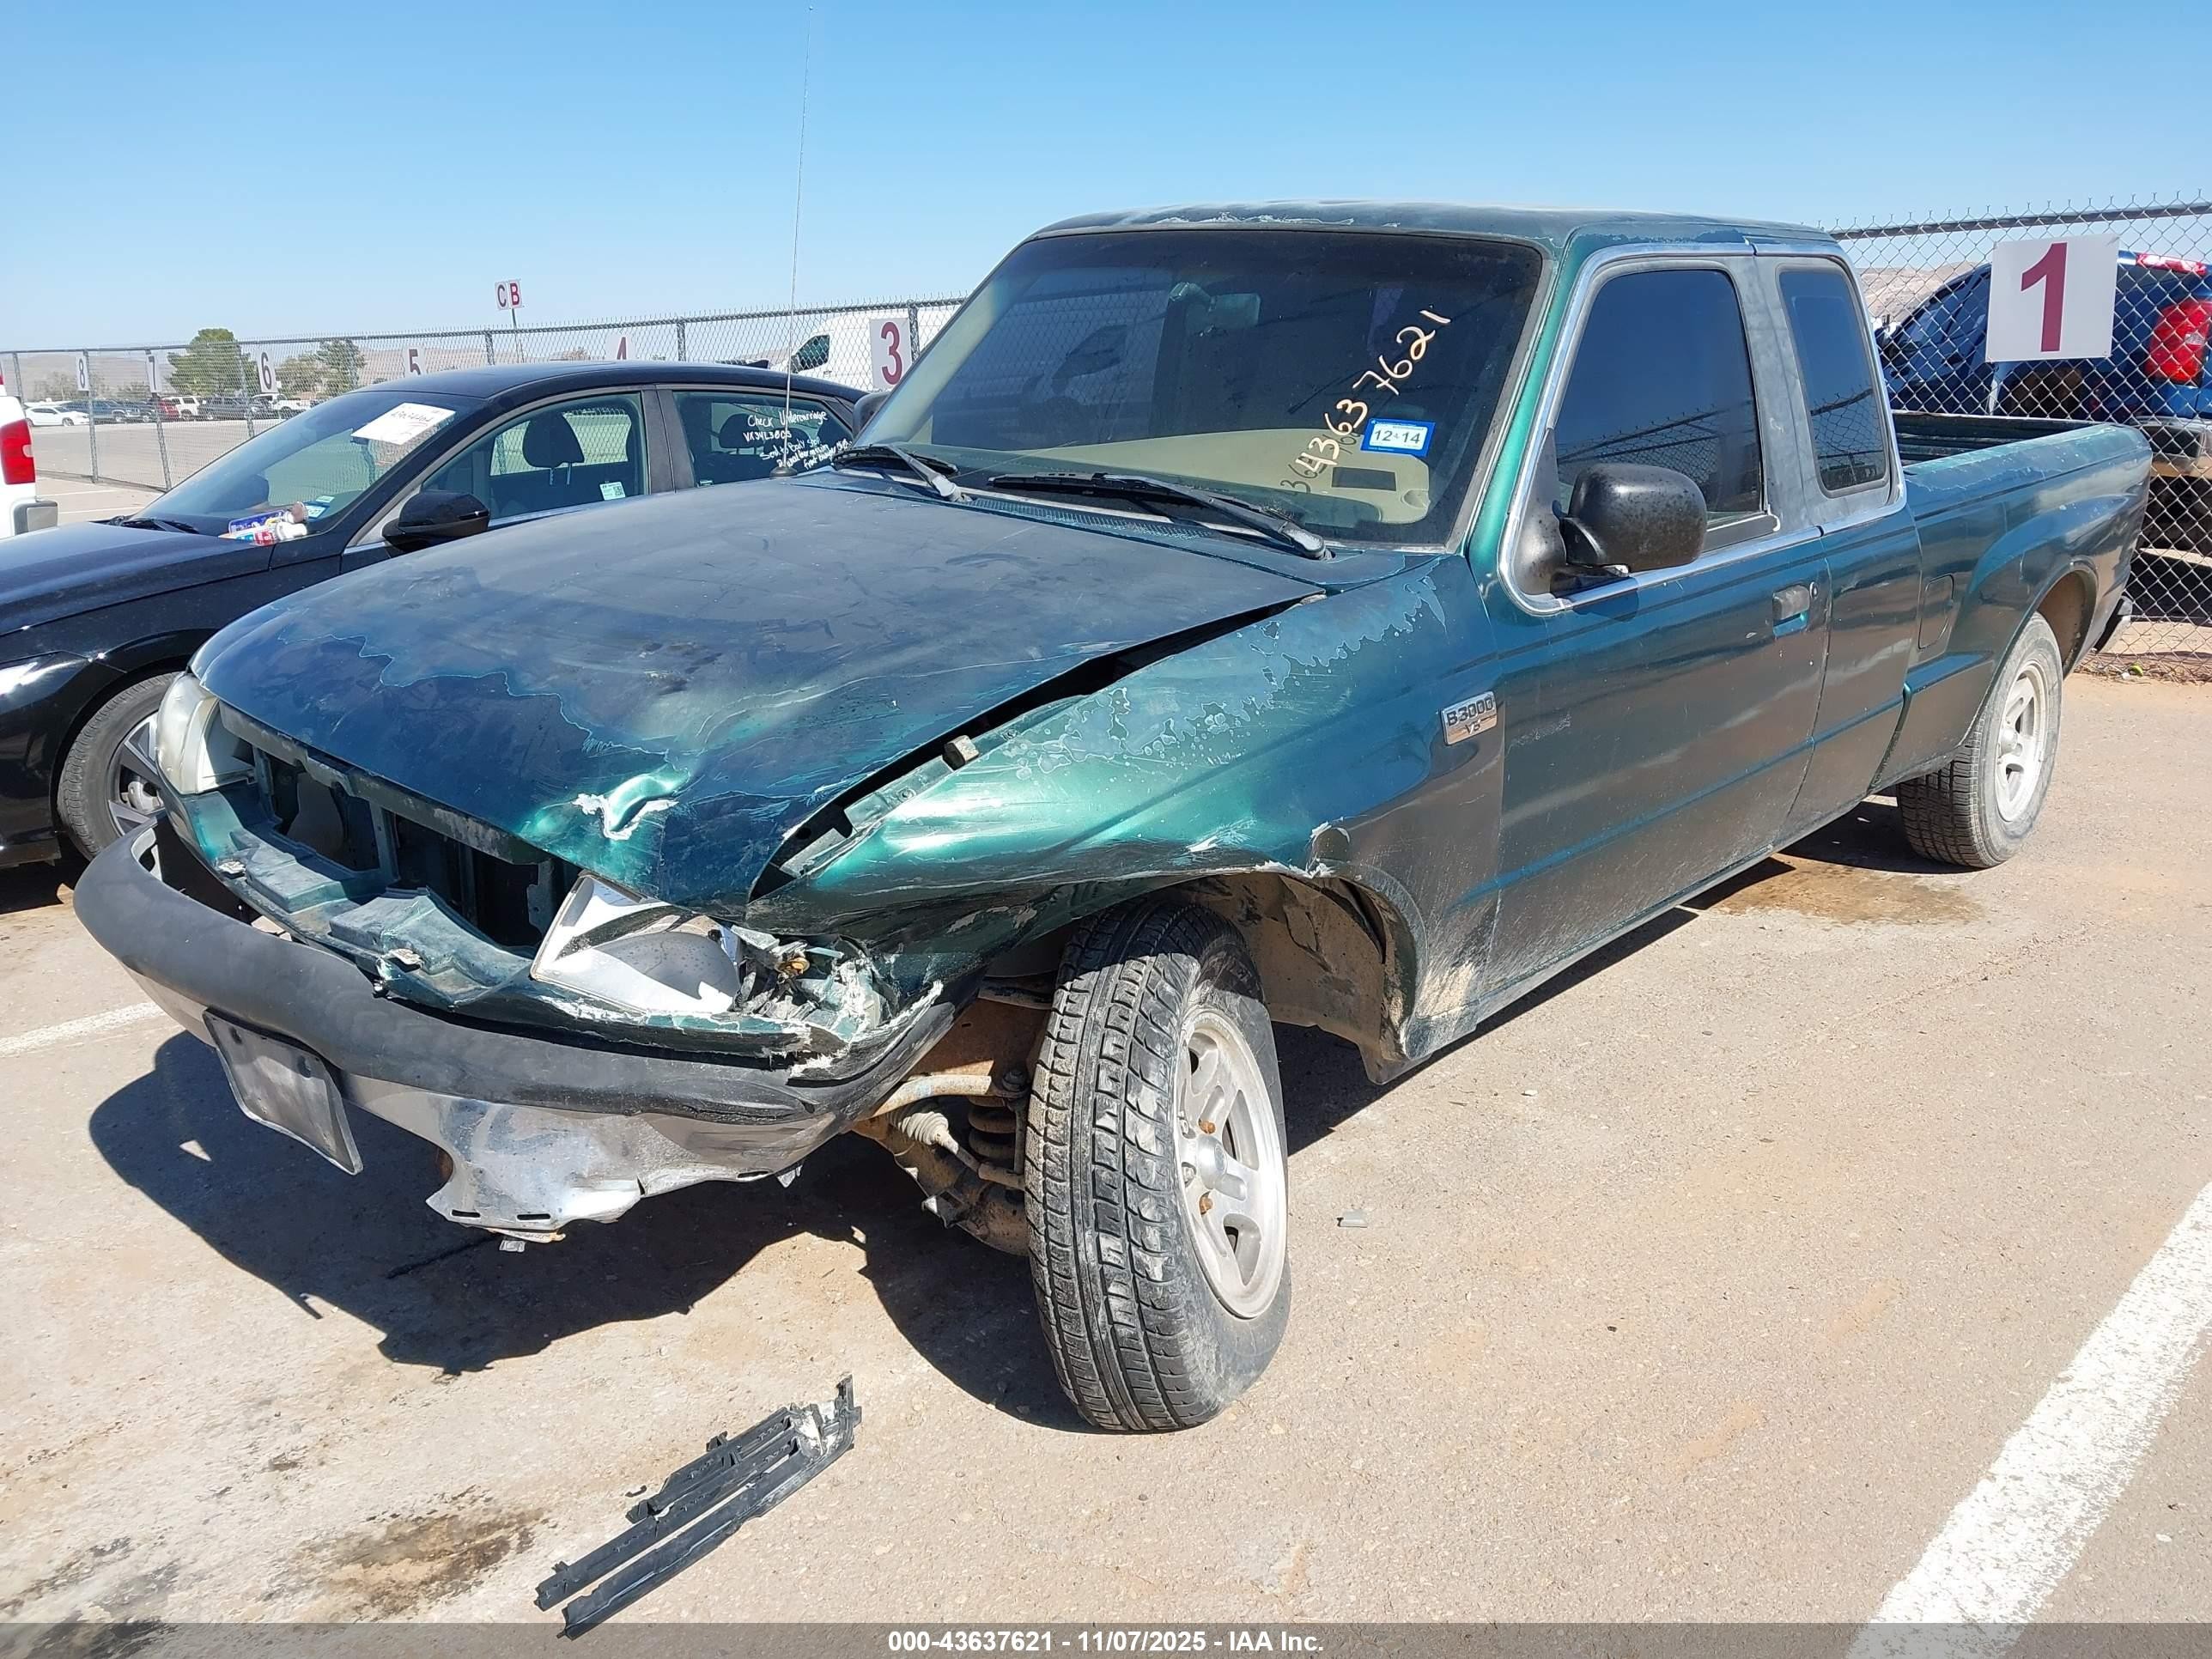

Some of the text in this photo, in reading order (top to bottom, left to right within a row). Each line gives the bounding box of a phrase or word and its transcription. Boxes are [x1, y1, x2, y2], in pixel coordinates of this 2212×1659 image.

[2021, 241, 2068, 353] 1
[880, 321, 902, 386] 3
[78, 357, 86, 388] 8
[148, 356, 157, 390] 7
[261, 352, 272, 390] 6
[747, 414, 775, 428] Check
[1375, 429, 1421, 445] 12 14
[1446, 697, 1493, 726] B3000
